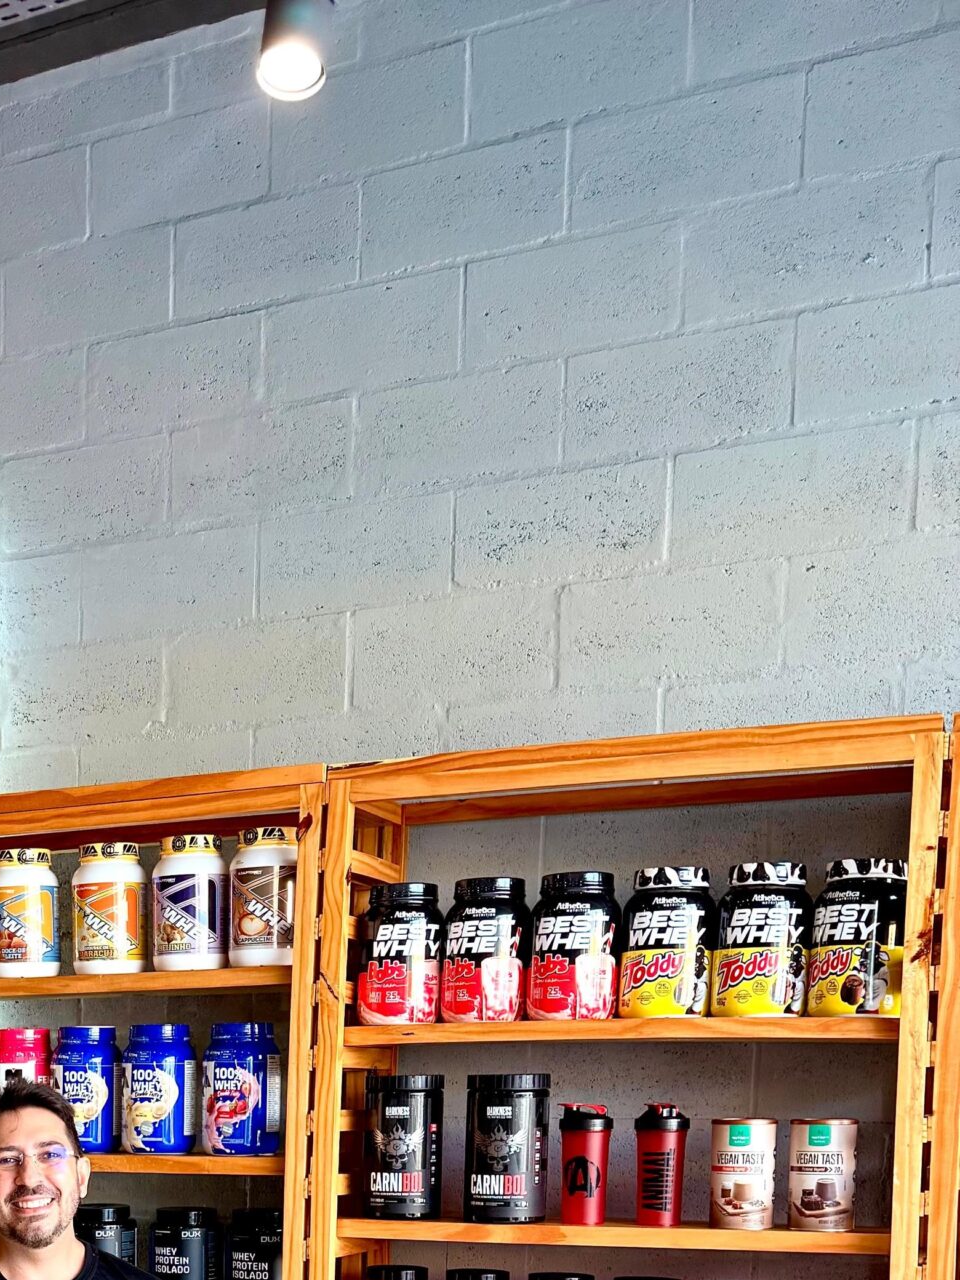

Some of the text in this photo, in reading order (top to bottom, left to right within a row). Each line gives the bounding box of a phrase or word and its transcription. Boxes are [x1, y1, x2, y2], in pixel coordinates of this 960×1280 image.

[633, 910, 705, 929] BEST
[731, 908, 803, 927] BEST
[814, 904, 876, 924] BEST
[449, 920, 515, 938] BEST
[538, 915, 610, 934] BEST
[376, 924, 439, 941] BEST
[726, 926, 804, 944] WHEY
[812, 922, 880, 943] WHEY
[623, 952, 685, 998] Toddy
[717, 949, 780, 995] Toddy
[809, 949, 853, 991] Toddy
[64, 1083, 93, 1093] WHEY
[133, 1082, 161, 1092] WHEY
[215, 1080, 242, 1090] WHEY
[717, 1153, 765, 1165] VEGAN TASTY
[796, 1153, 844, 1165] VEGAN TASTY
[370, 1172, 424, 1192] CARNIBOL
[471, 1174, 528, 1195] CARNIBOL
[642, 1149, 674, 1212] ANIMAL
[95, 1230, 115, 1238] DUX
[181, 1230, 201, 1238] DUX
[260, 1235, 280, 1243] DUX
[155, 1247, 177, 1256] WHEY
[232, 1252, 255, 1261] WHEY
[155, 1256, 189, 1265] PROTEIN
[232, 1261, 269, 1271] PROTEIN
[155, 1264, 190, 1274] ISOLADO
[232, 1270, 269, 1280] ISOLADO
